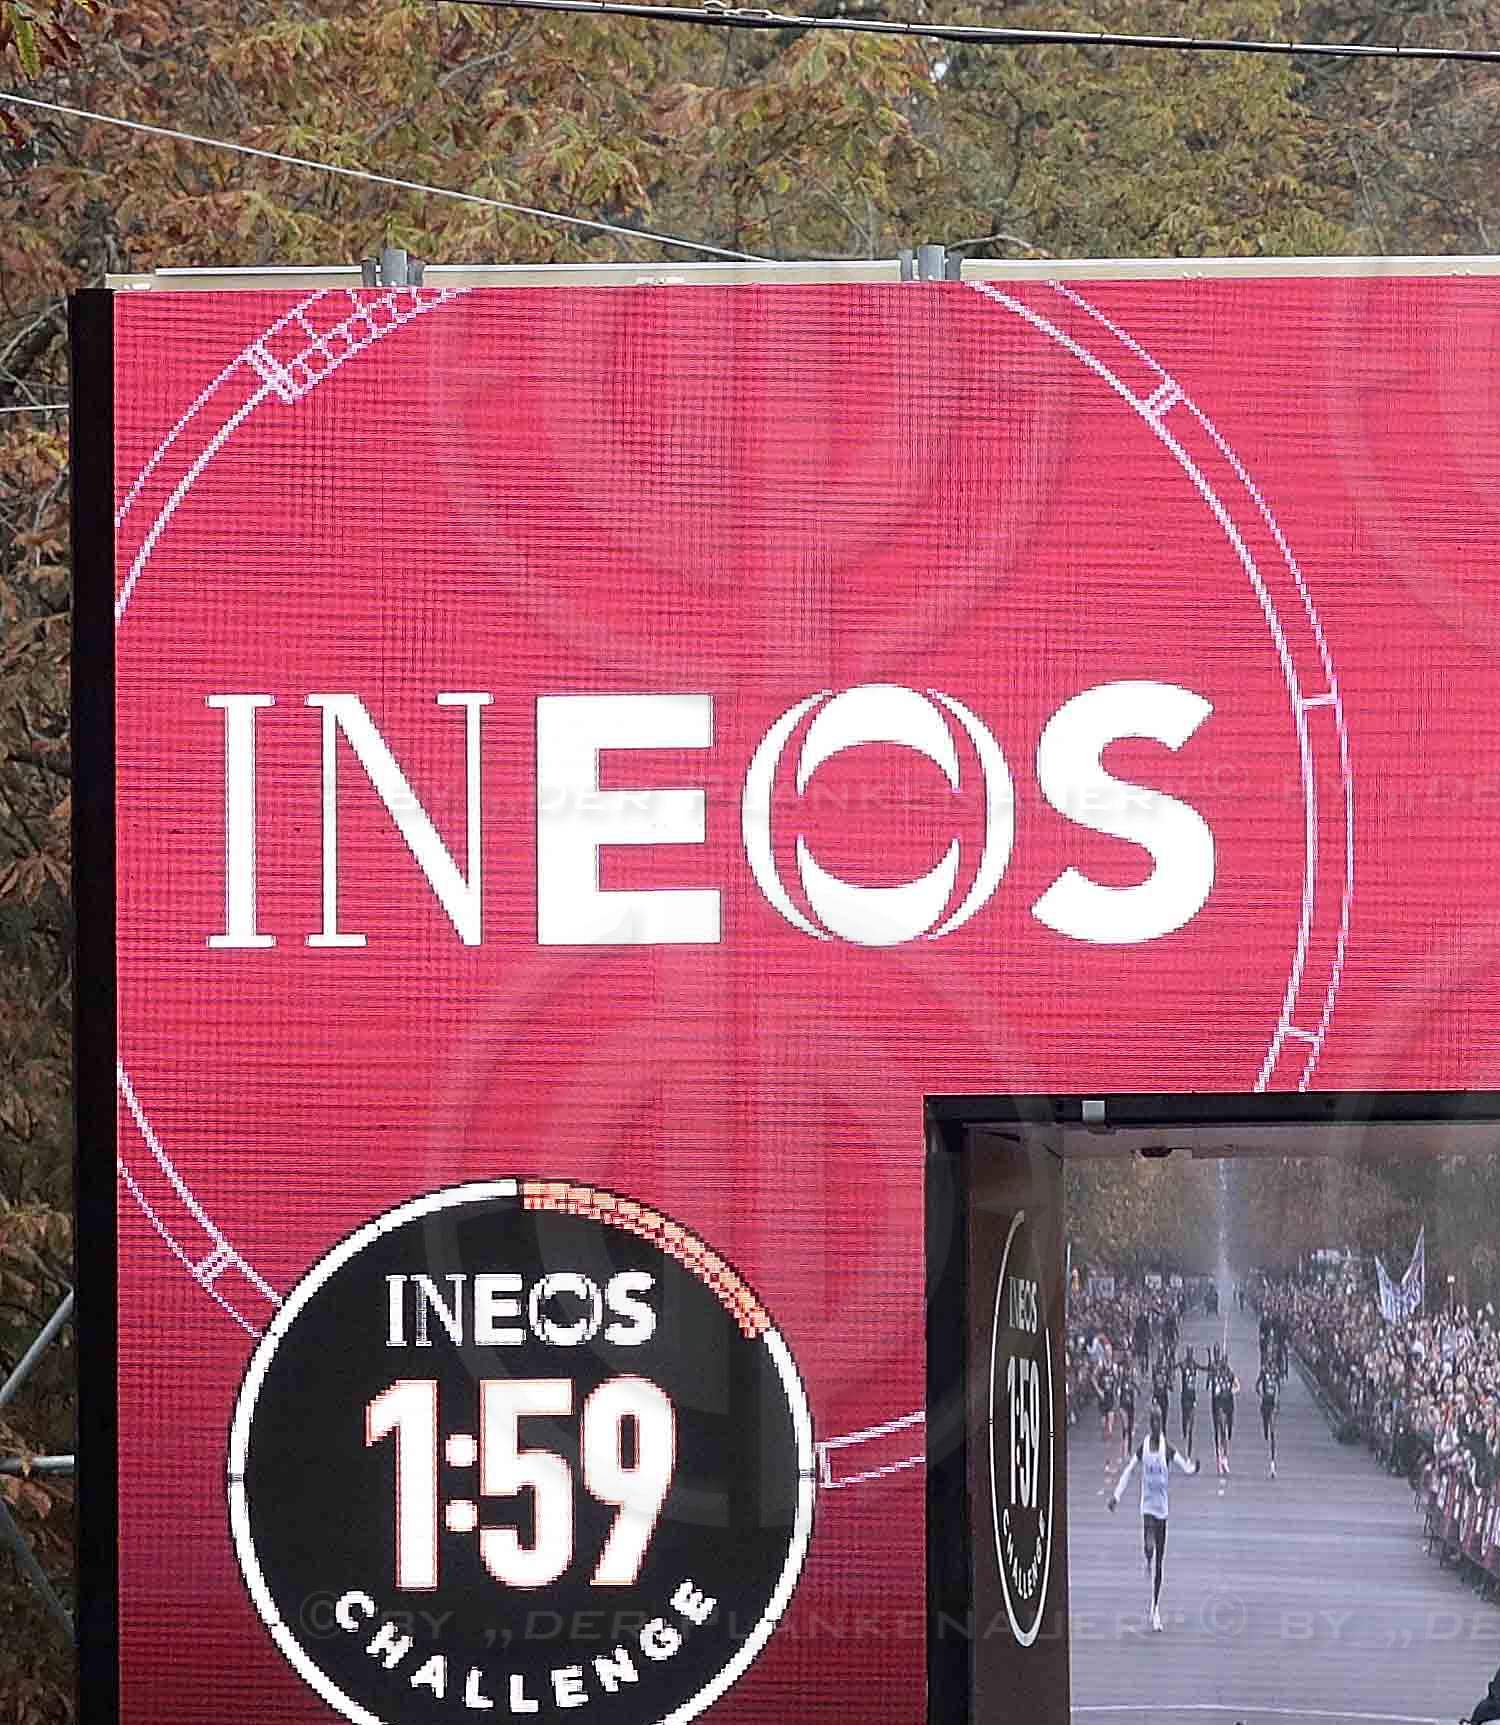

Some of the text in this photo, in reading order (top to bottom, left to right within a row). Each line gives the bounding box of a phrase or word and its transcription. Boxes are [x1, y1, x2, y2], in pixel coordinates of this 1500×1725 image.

[206, 679, 1216, 948] INEOS
[386, 1272, 658, 1348] INEOS
[364, 1374, 677, 1593] 1:59
[1007, 1355, 1041, 1508] 1:59
[333, 1577, 720, 1714] CHALLENGE
